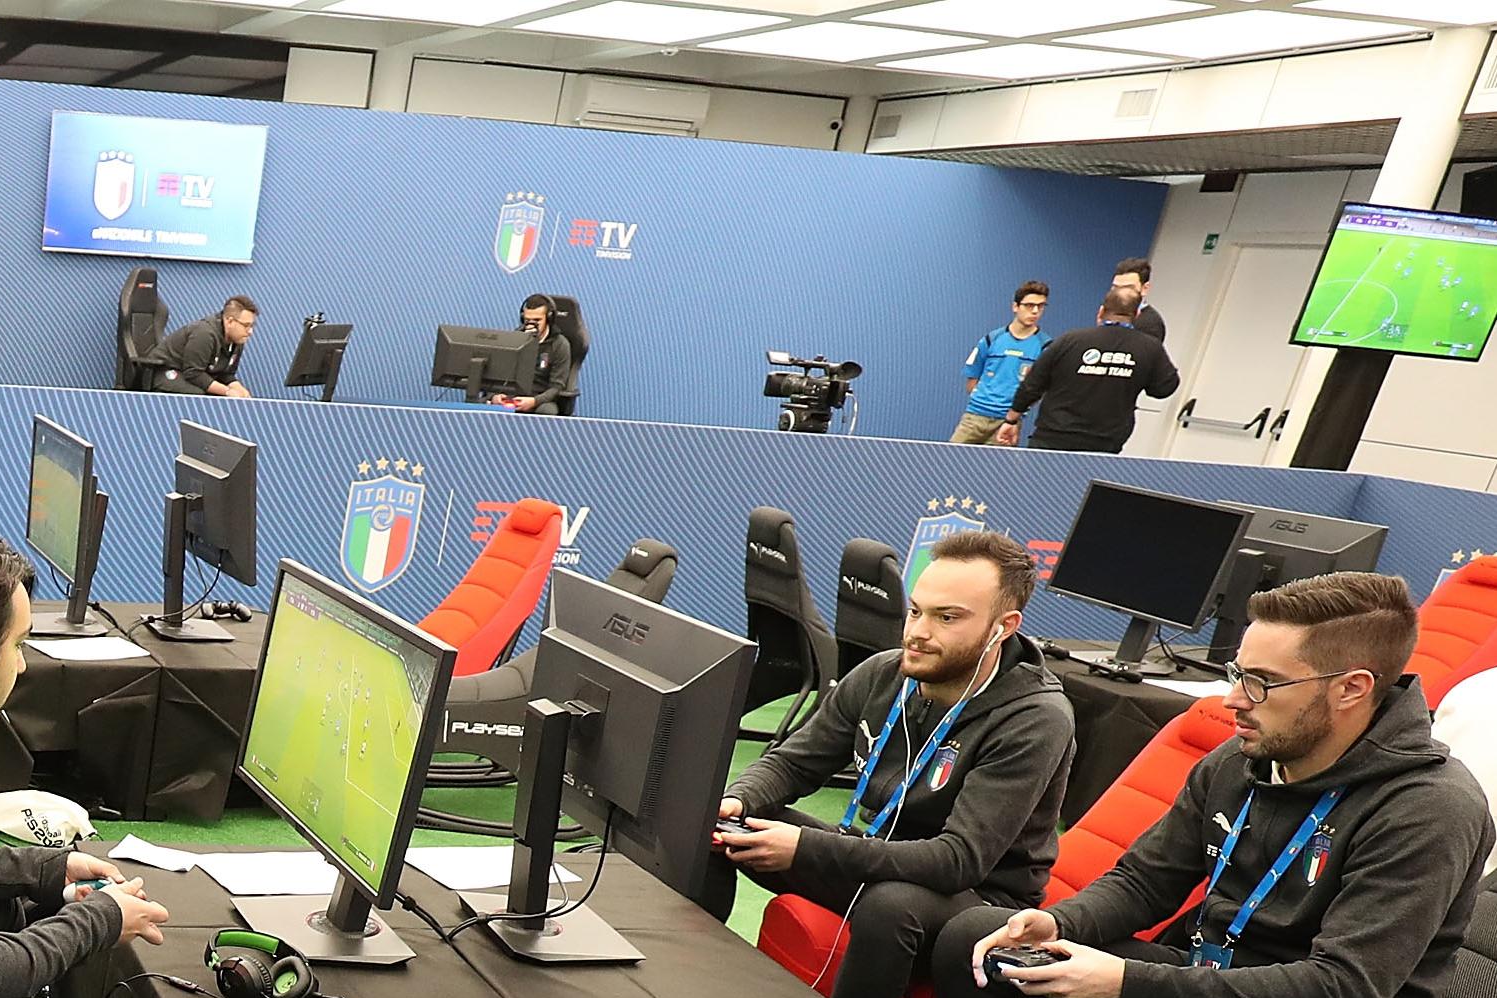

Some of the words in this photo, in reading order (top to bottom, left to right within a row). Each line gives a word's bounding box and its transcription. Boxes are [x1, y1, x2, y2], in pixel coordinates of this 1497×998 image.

[182, 174, 215, 199] TV
[600, 221, 638, 249] TV
[1100, 352, 1136, 366] ESL
[355, 487, 416, 507] ITALIA
[1269, 519, 1310, 534] ASUS
[602, 612, 650, 646] ASUS
[452, 722, 524, 737] PLAYSE
